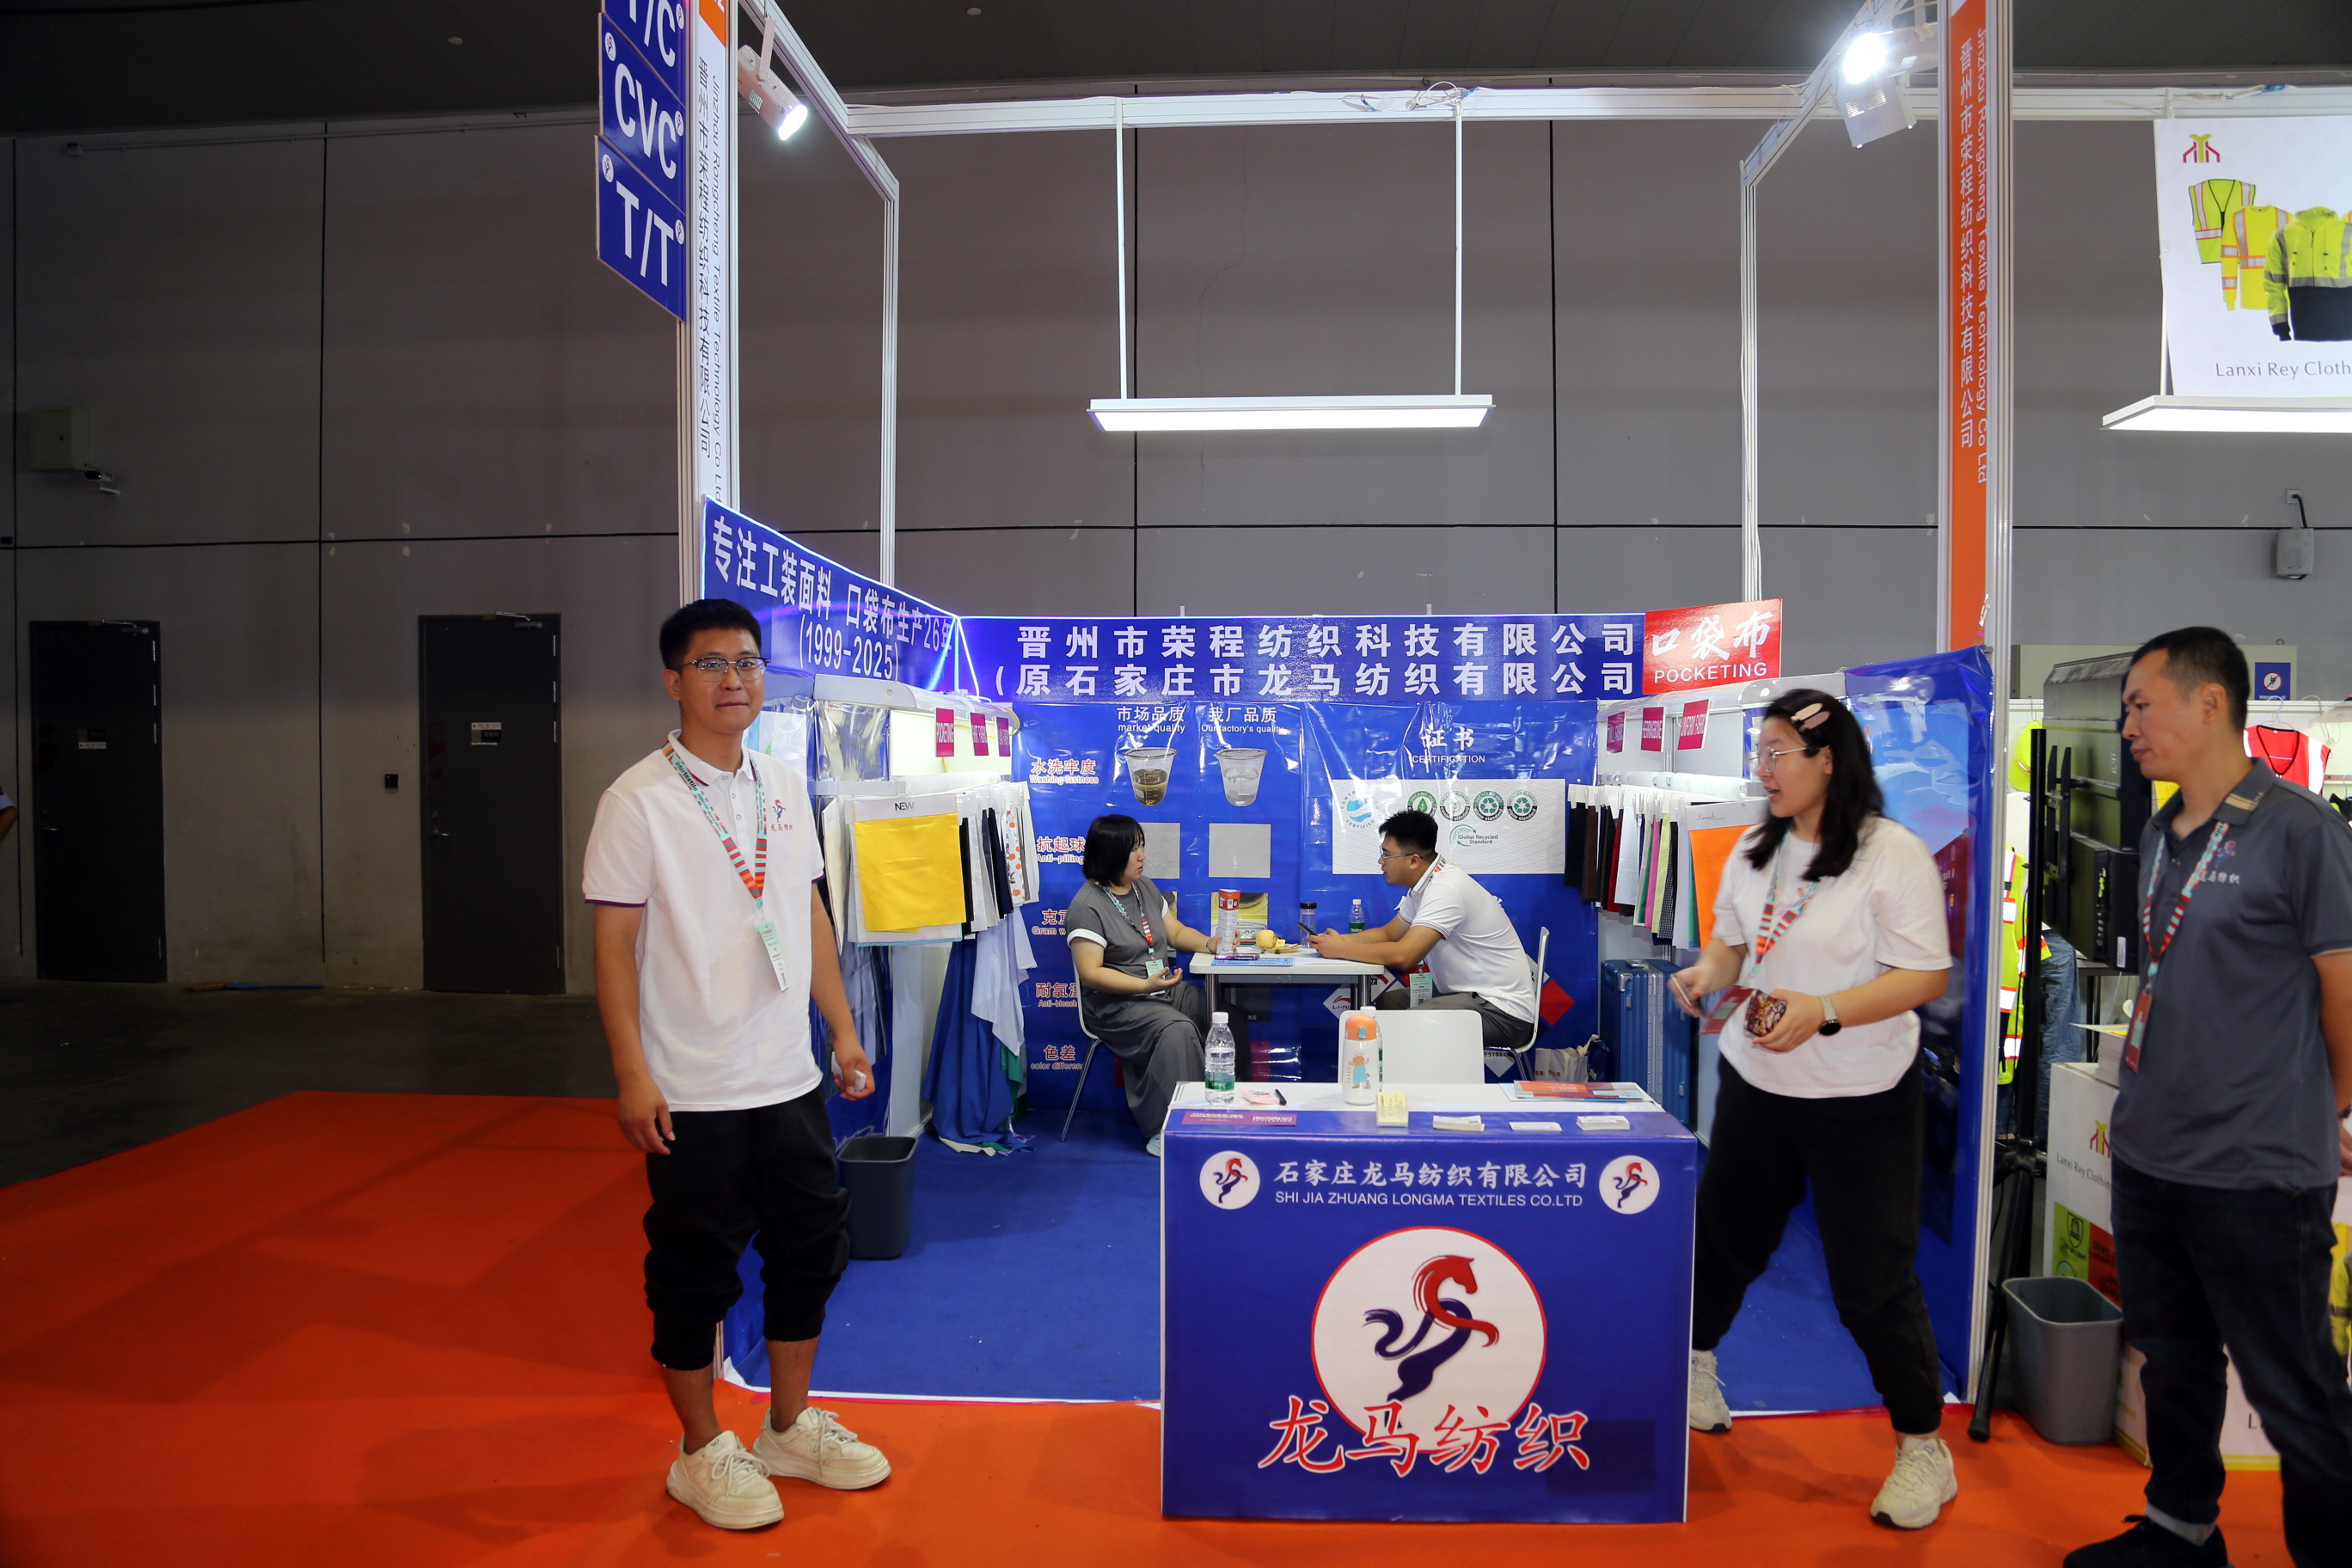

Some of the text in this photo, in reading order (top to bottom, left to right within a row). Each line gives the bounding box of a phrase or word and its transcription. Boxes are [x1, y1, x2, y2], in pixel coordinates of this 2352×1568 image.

[614, 63, 677, 180] CVC
[616, 180, 675, 288] T/T
[1960, 36, 1975, 449] 晋州市荣程纺织科技有限公司
[1976, 28, 1988, 484] Jinzhou Rongcheng Textile Technology Co Ltd
[711, 75, 722, 504] Jinzhou Rongcheng Textile Technology Co Ltd
[2215, 362, 2263, 377] Lanxi
[2268, 361, 2300, 380] Rey
[712, 515, 954, 657] 专注工装面料 口袋布生产26年
[1016, 623, 1634, 659] 晋州市荣程纺织科技有限公司
[1651, 609, 1774, 661] 口袋布
[798, 614, 901, 682] (1999-2025)
[1653, 662, 1768, 684] POCKETING
[1116, 706, 1278, 723] 市场品质 我厂品质
[1118, 723, 1185, 733] market quality
[1421, 726, 1475, 751] 证书
[1030, 758, 1097, 775] 水洗牢度
[1412, 754, 1485, 763] CERTIFICATION
[674, 760, 698, 792] intertextile
[1029, 775, 1099, 786] Washing fastness
[894, 801, 915, 812] NEW
[1345, 819, 1375, 830] CERTIFIED
[1036, 836, 1087, 853] 抗起球
[1036, 854, 1085, 865] Anti-pilling
[1032, 926, 1066, 935] Gram
[1043, 1044, 1076, 1062] 色差
[1030, 1062, 1051, 1070] color
[1273, 1159, 1588, 1190] 石家庄龙马纺织有限公司
[2073, 1161, 2086, 1179] Rey
[2086, 1167, 2111, 1190] Clothin
[1275, 1191, 1583, 1207] SHI JIA ZHUANG LONGMA TEXTILES CO.LTD
[1258, 1395, 1591, 1478] 龙马纺织
